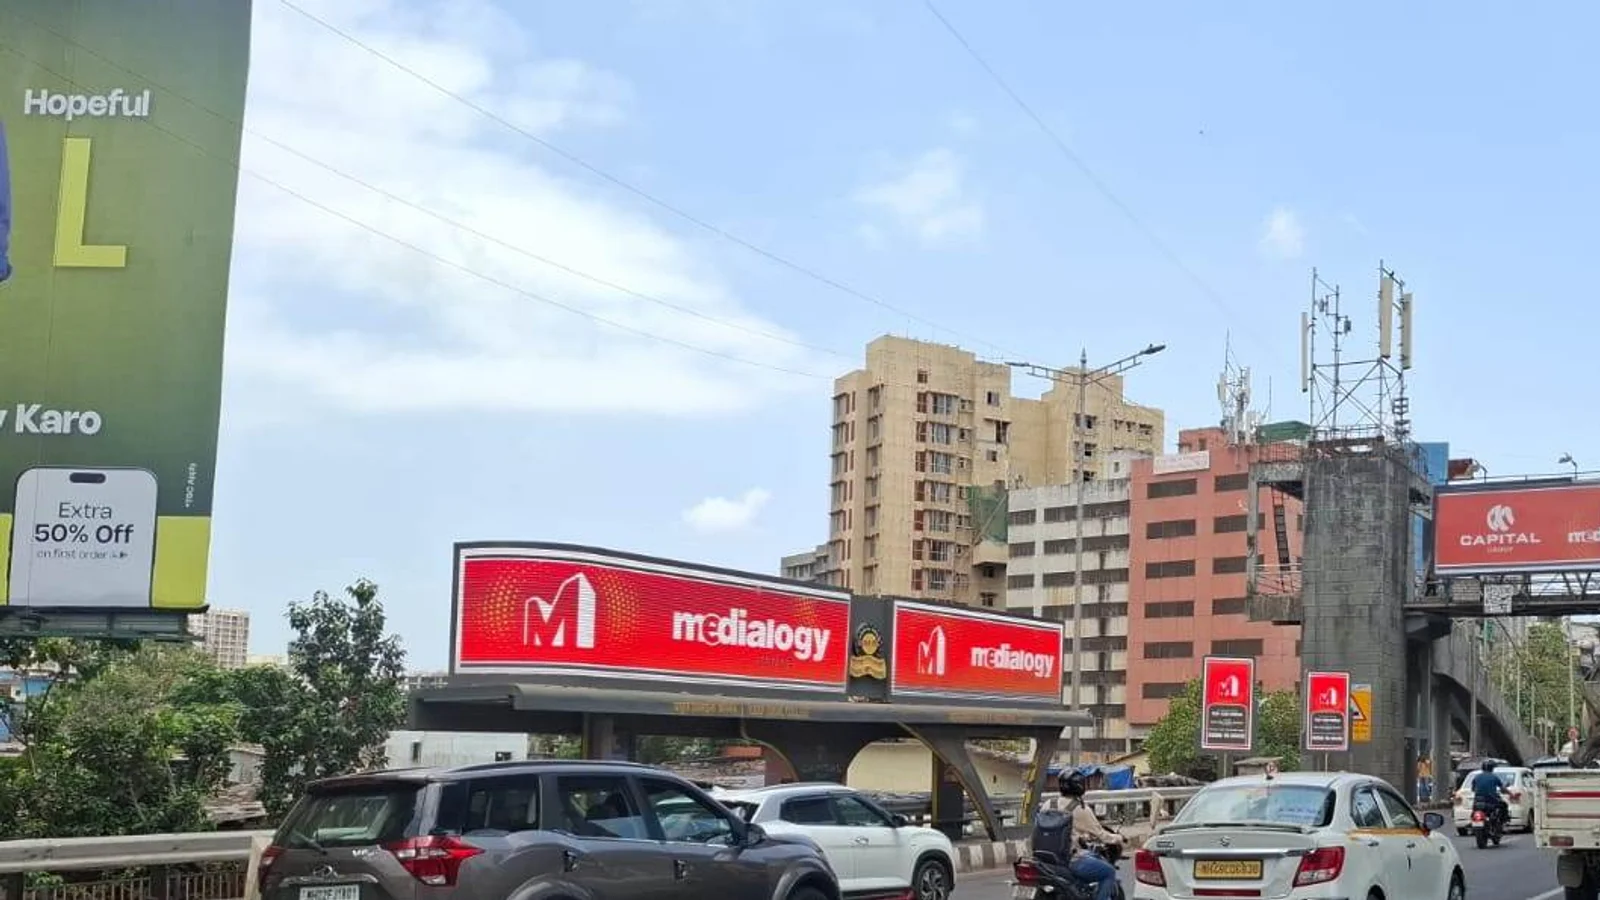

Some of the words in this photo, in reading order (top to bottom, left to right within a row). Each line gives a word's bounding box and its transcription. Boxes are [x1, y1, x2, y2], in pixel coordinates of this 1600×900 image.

[24, 87, 151, 121] Hopeful
[53, 137, 127, 268] L
[15, 403, 102, 435] Karo
[58, 502, 112, 519] Extra
[34, 524, 88, 543] 50%
[96, 524, 134, 544] Off
[1460, 532, 1542, 547] CAPITAL
[36, 551, 52, 559] on
[53, 549, 76, 560] first
[78, 551, 108, 560] order
[672, 607, 831, 664] medialogy
[974, 644, 1055, 679] medialogy
